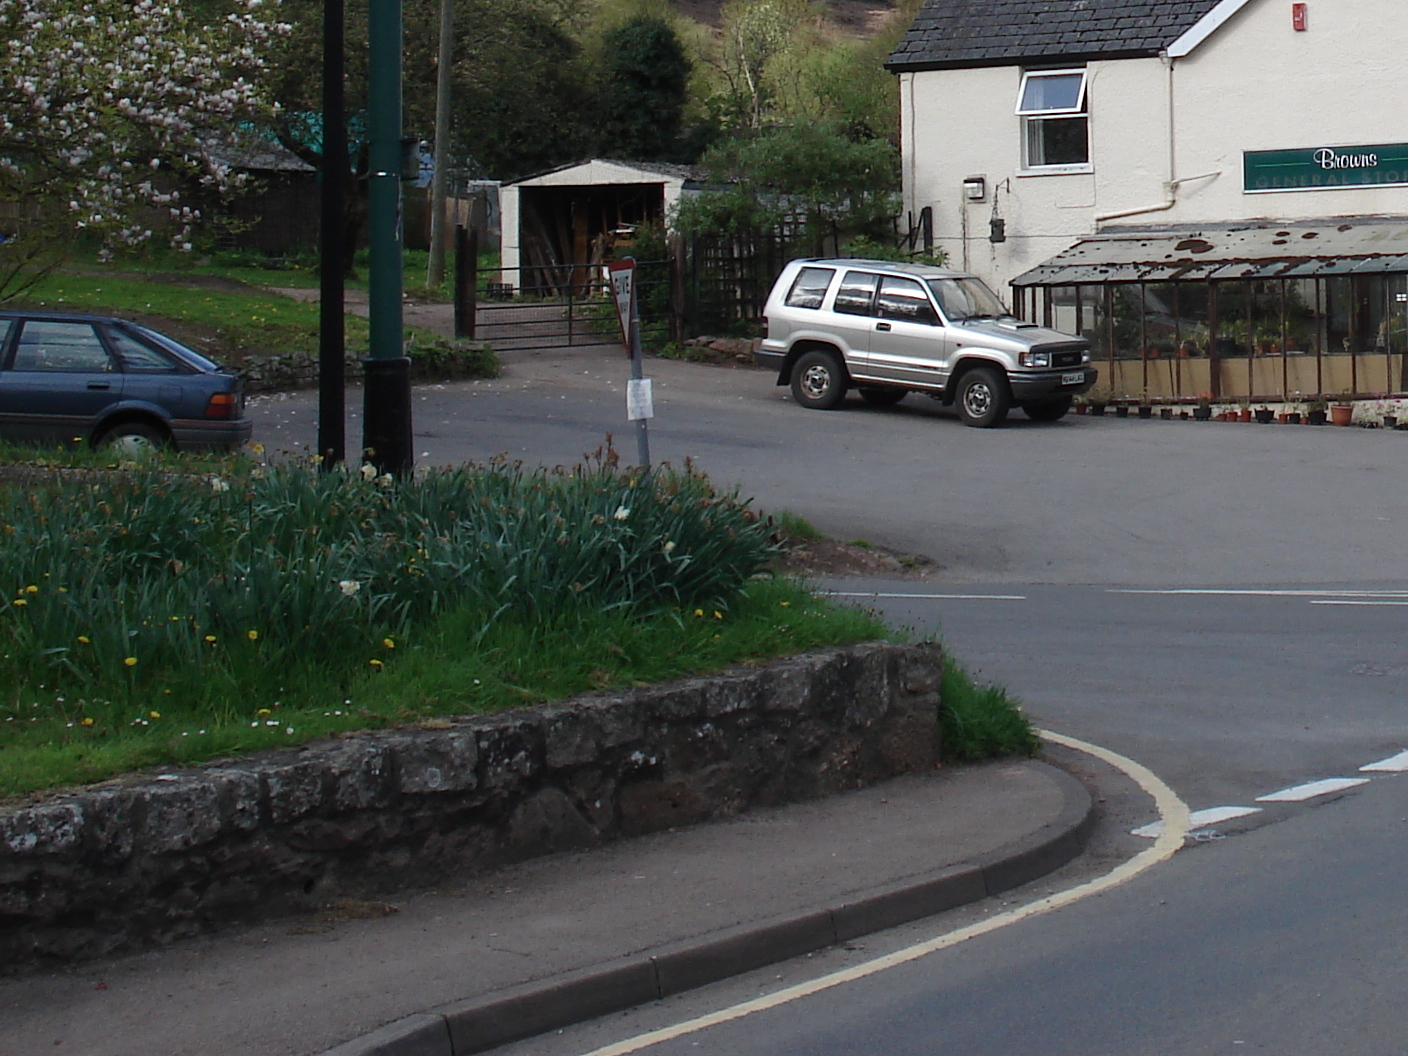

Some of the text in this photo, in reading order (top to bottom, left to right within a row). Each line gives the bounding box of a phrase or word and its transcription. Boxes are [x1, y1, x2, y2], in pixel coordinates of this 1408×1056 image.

[1313, 148, 1377, 170] Browns
[1254, 174, 1350, 189] GENERAL
[615, 275, 631, 296] GIVE
